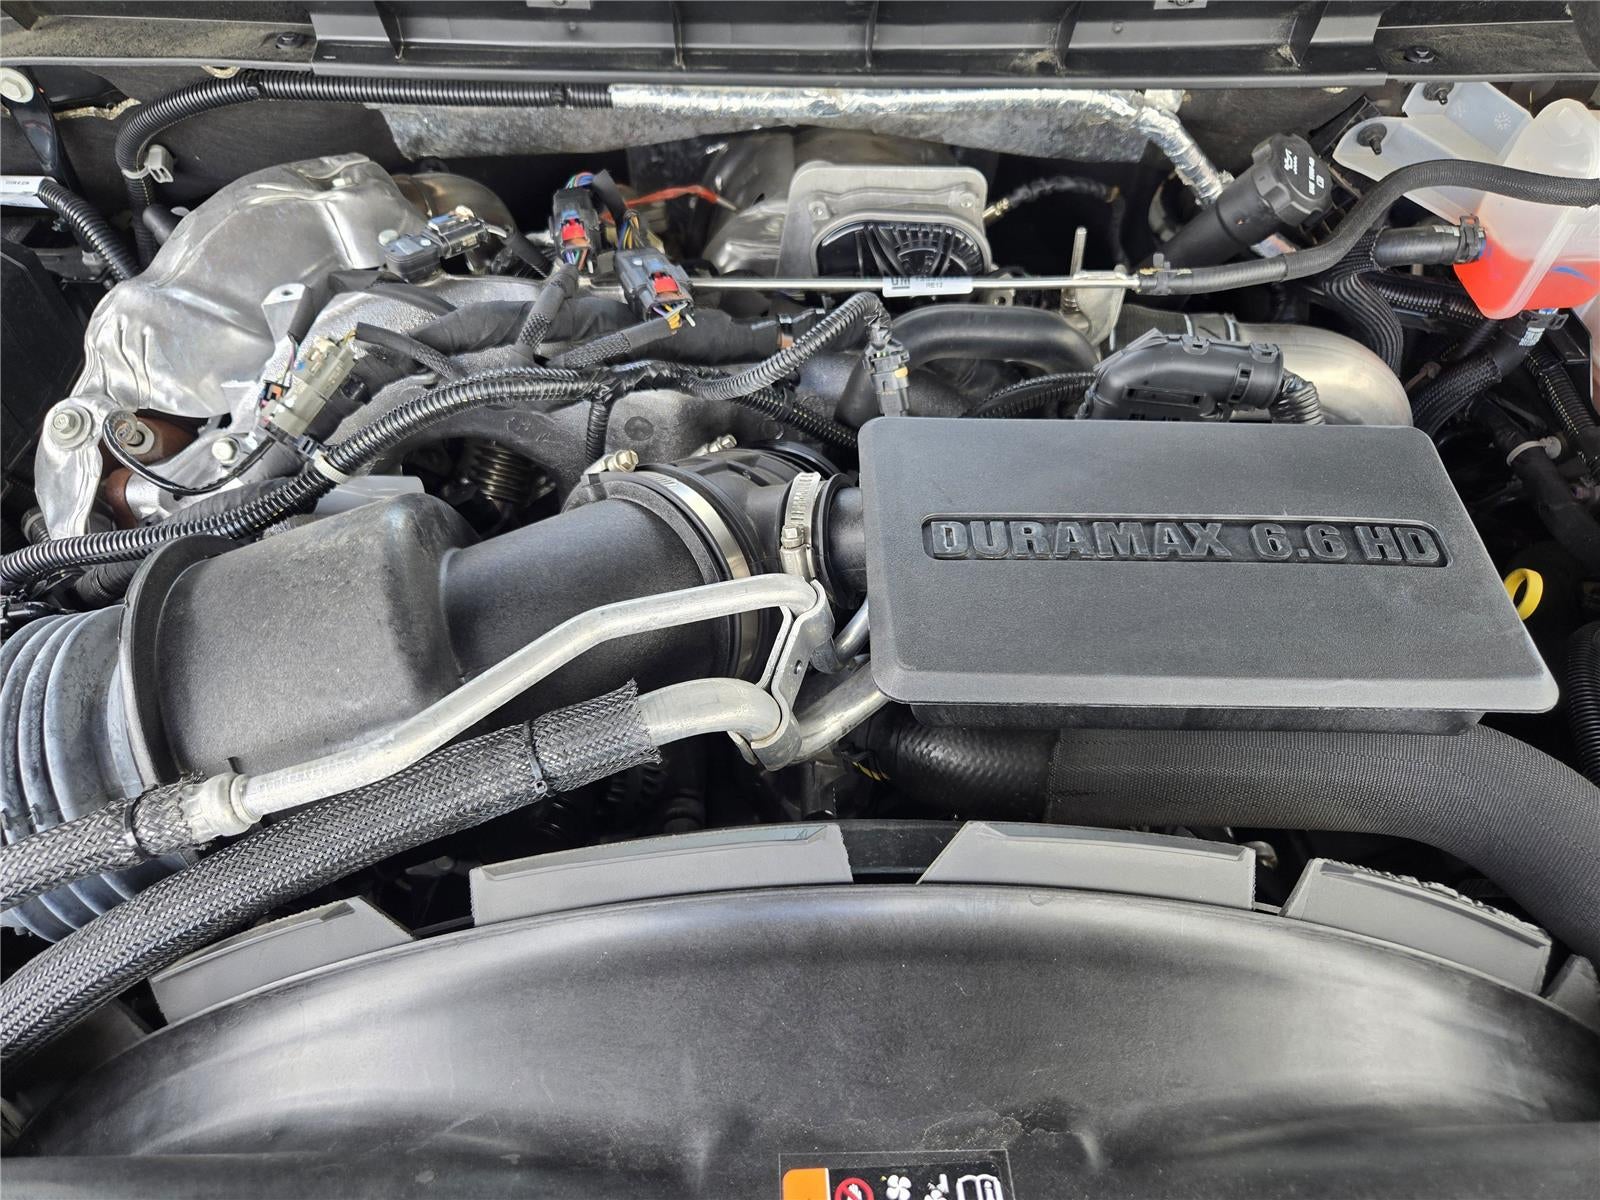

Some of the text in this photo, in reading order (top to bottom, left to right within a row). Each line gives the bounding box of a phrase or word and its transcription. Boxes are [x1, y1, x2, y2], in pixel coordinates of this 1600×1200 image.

[930, 521, 1441, 563] DURAMAX 6.6 HD
